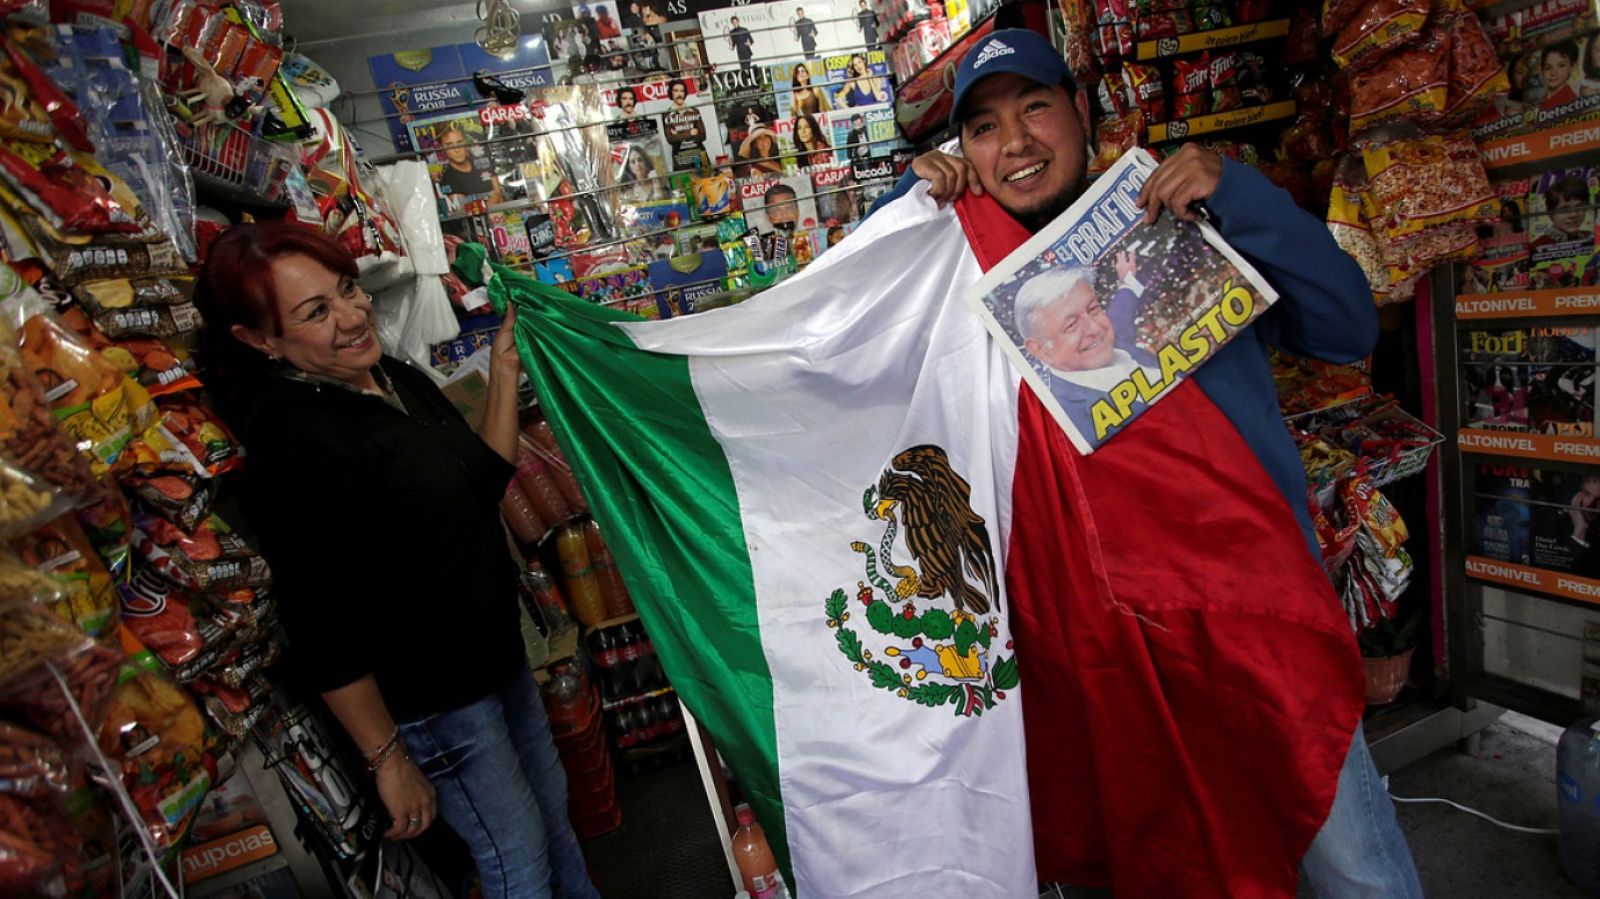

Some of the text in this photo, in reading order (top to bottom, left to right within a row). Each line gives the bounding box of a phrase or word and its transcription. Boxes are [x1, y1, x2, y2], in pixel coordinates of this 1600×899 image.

[973, 47, 1015, 69] adidas
[414, 83, 460, 106] RUSSIA
[643, 81, 669, 99] Qui
[866, 110, 893, 122] Salud
[1539, 92, 1600, 121] Detective
[1055, 243, 1073, 263] EL
[1455, 298, 1537, 314] ALTONIVEL
[1090, 278, 1254, 441] APLASTÓ
[1457, 434, 1537, 451] ALTONIVEL
[1465, 560, 1541, 585] ALTONIVEL
[183, 831, 273, 873] nupcias
